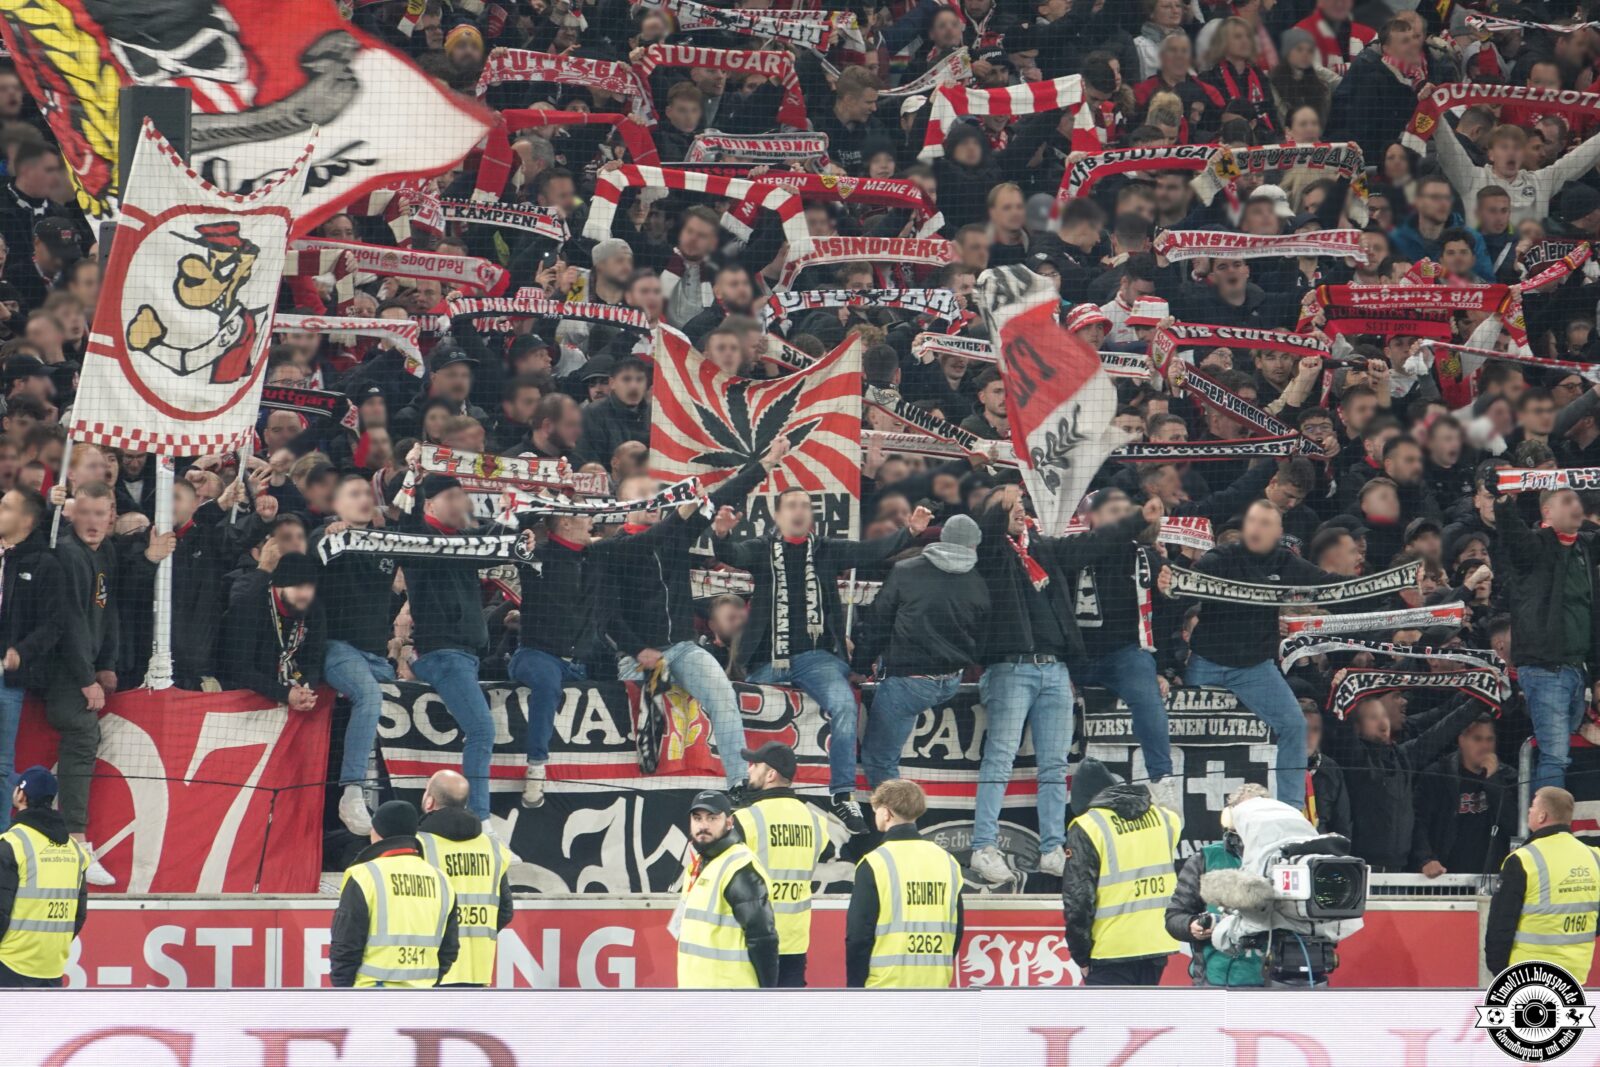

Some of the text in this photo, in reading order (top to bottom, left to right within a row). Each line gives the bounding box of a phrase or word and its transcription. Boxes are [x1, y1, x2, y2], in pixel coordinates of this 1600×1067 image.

[648, 44, 796, 75] STUTTGART
[1069, 157, 1099, 188] VfB
[862, 180, 907, 195] MEINE
[1306, 231, 1361, 245] KURV
[400, 253, 435, 271] Dogs
[445, 259, 465, 275] Red
[1350, 288, 1443, 303] Stuttgart
[262, 387, 336, 409] uttgart
[1085, 718, 1268, 738] VERSTENEN ULTRAS
[770, 823, 814, 848] SECURITY
[445, 852, 491, 877] SECURITY
[391, 873, 437, 899] SECURITY
[906, 881, 947, 906] SECURITY
[1134, 876, 1166, 898] 3703
[1563, 914, 1588, 933] 0160
[907, 934, 943, 954] 3262
[397, 946, 426, 966] 3541
